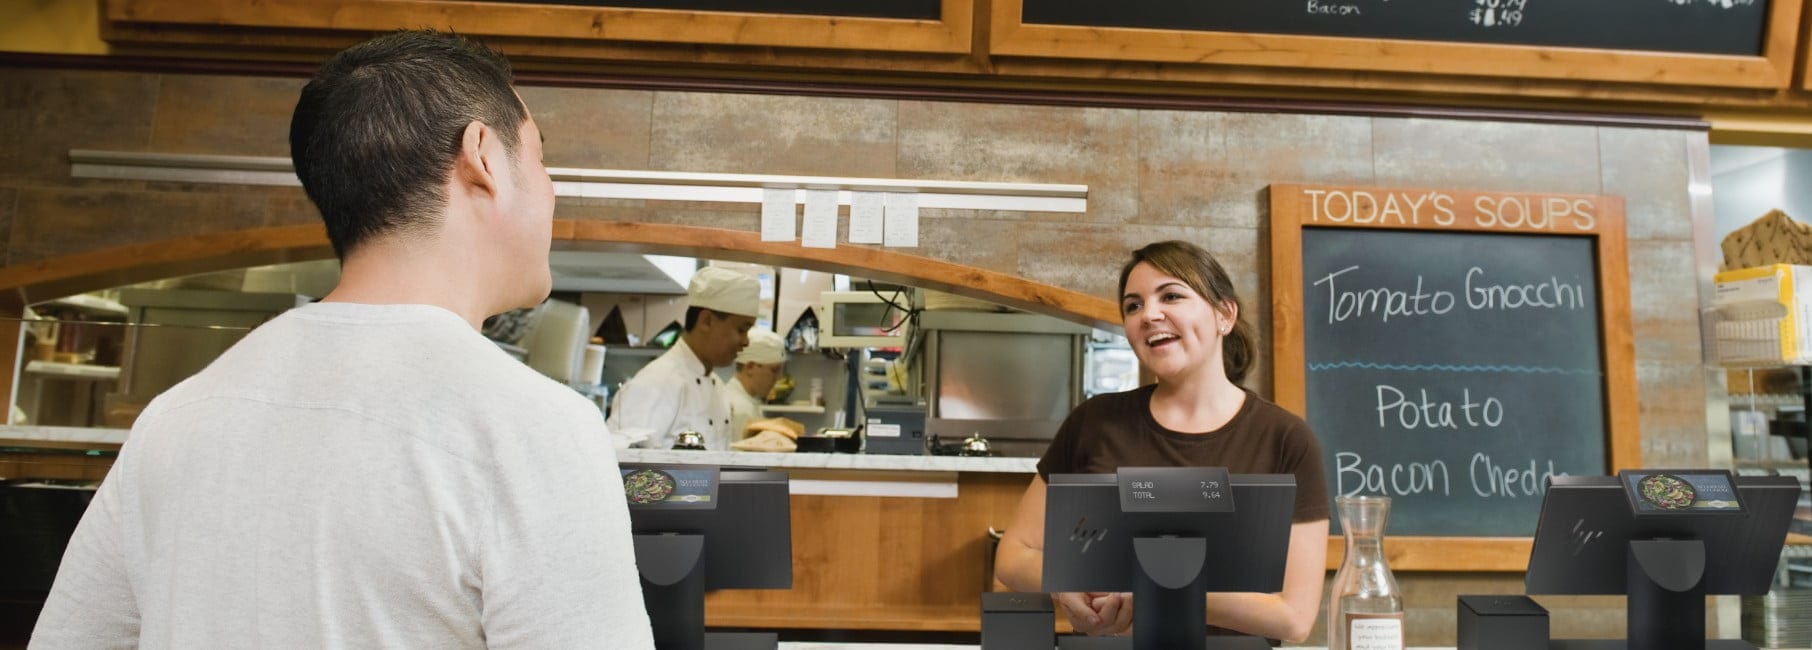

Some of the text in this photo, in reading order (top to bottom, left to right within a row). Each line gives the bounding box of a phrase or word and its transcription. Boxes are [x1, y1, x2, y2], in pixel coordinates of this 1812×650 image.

[1307, 0, 1360, 15] Bacon
[1304, 190, 1595, 230] TODAY'S SOUPS
[1313, 265, 1585, 325] Tomato Gnocchi
[1376, 385, 1503, 429] Potato
[1131, 481, 1219, 489] SALAD 7.79
[1336, 452, 1450, 497] Bacon
[1132, 491, 1221, 499] TOTAL 9.64
